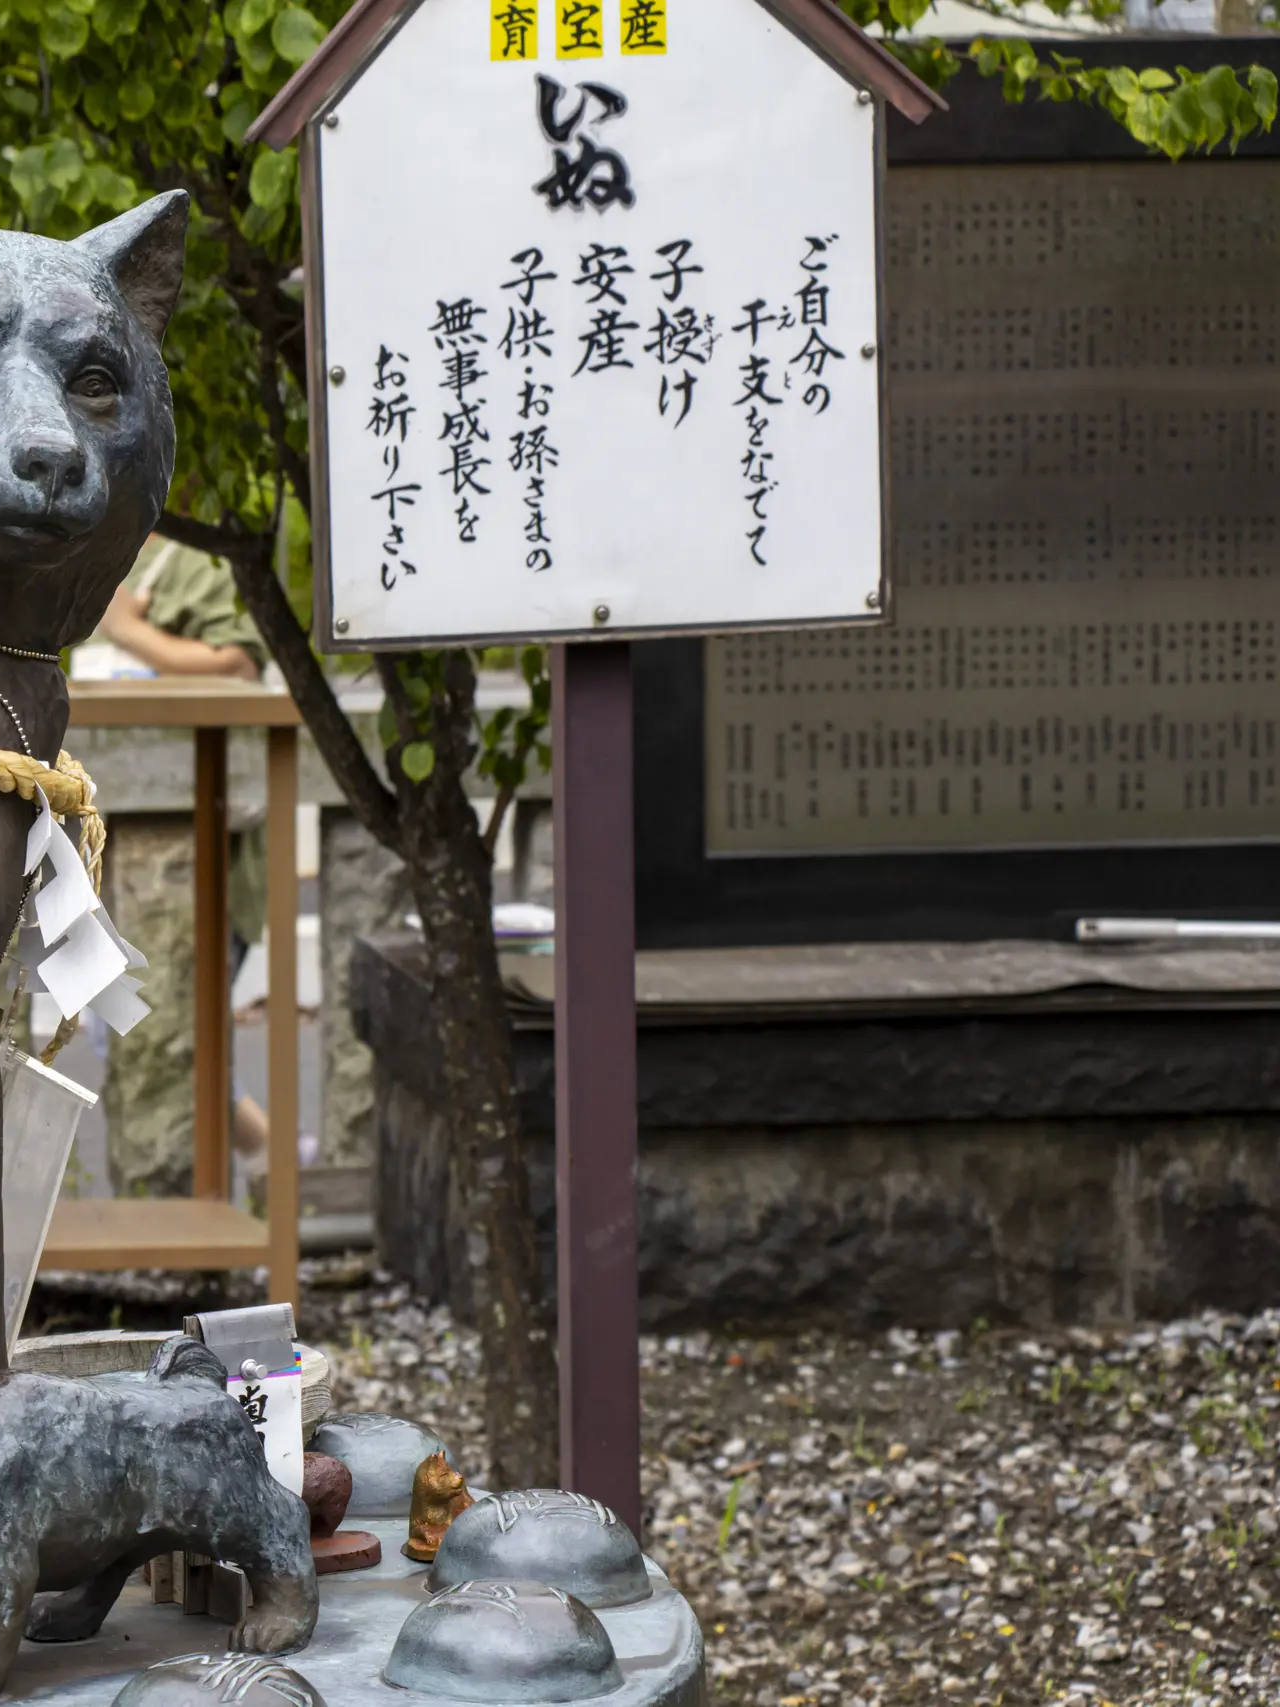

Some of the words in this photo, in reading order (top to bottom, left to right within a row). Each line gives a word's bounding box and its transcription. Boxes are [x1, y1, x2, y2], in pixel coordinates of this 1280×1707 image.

[533, 72, 636, 214] いぬ
[497, 247, 559, 573] 子供・お孫さまの
[571, 242, 640, 378] 安産
[788, 233, 846, 415] ご自分の
[365, 344, 422, 591] お祈り下さい
[428, 297, 492, 543] 無事成長を
